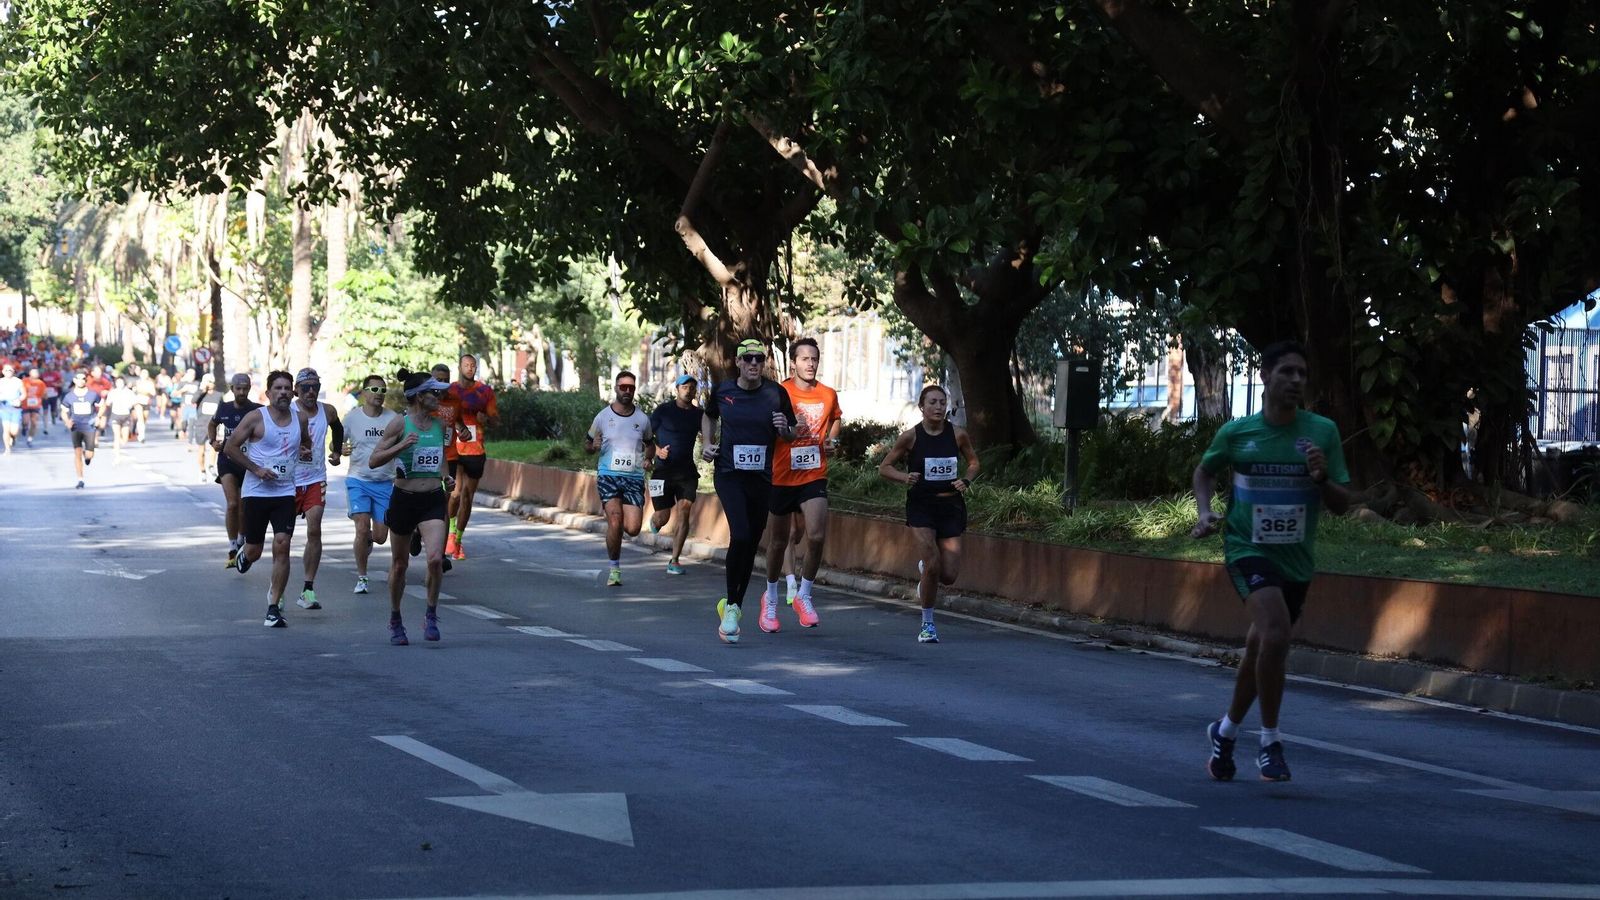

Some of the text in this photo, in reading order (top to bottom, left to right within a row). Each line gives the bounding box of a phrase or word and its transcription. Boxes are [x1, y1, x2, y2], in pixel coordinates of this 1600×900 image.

[365, 427, 384, 437] nike
[417, 455, 439, 465] 828
[614, 458, 632, 466] 976
[738, 454, 761, 463] 510
[795, 453, 815, 463] 321
[930, 466, 952, 474] 435
[1250, 464, 1305, 474] ATLETISMO
[1261, 518, 1297, 532] 362
